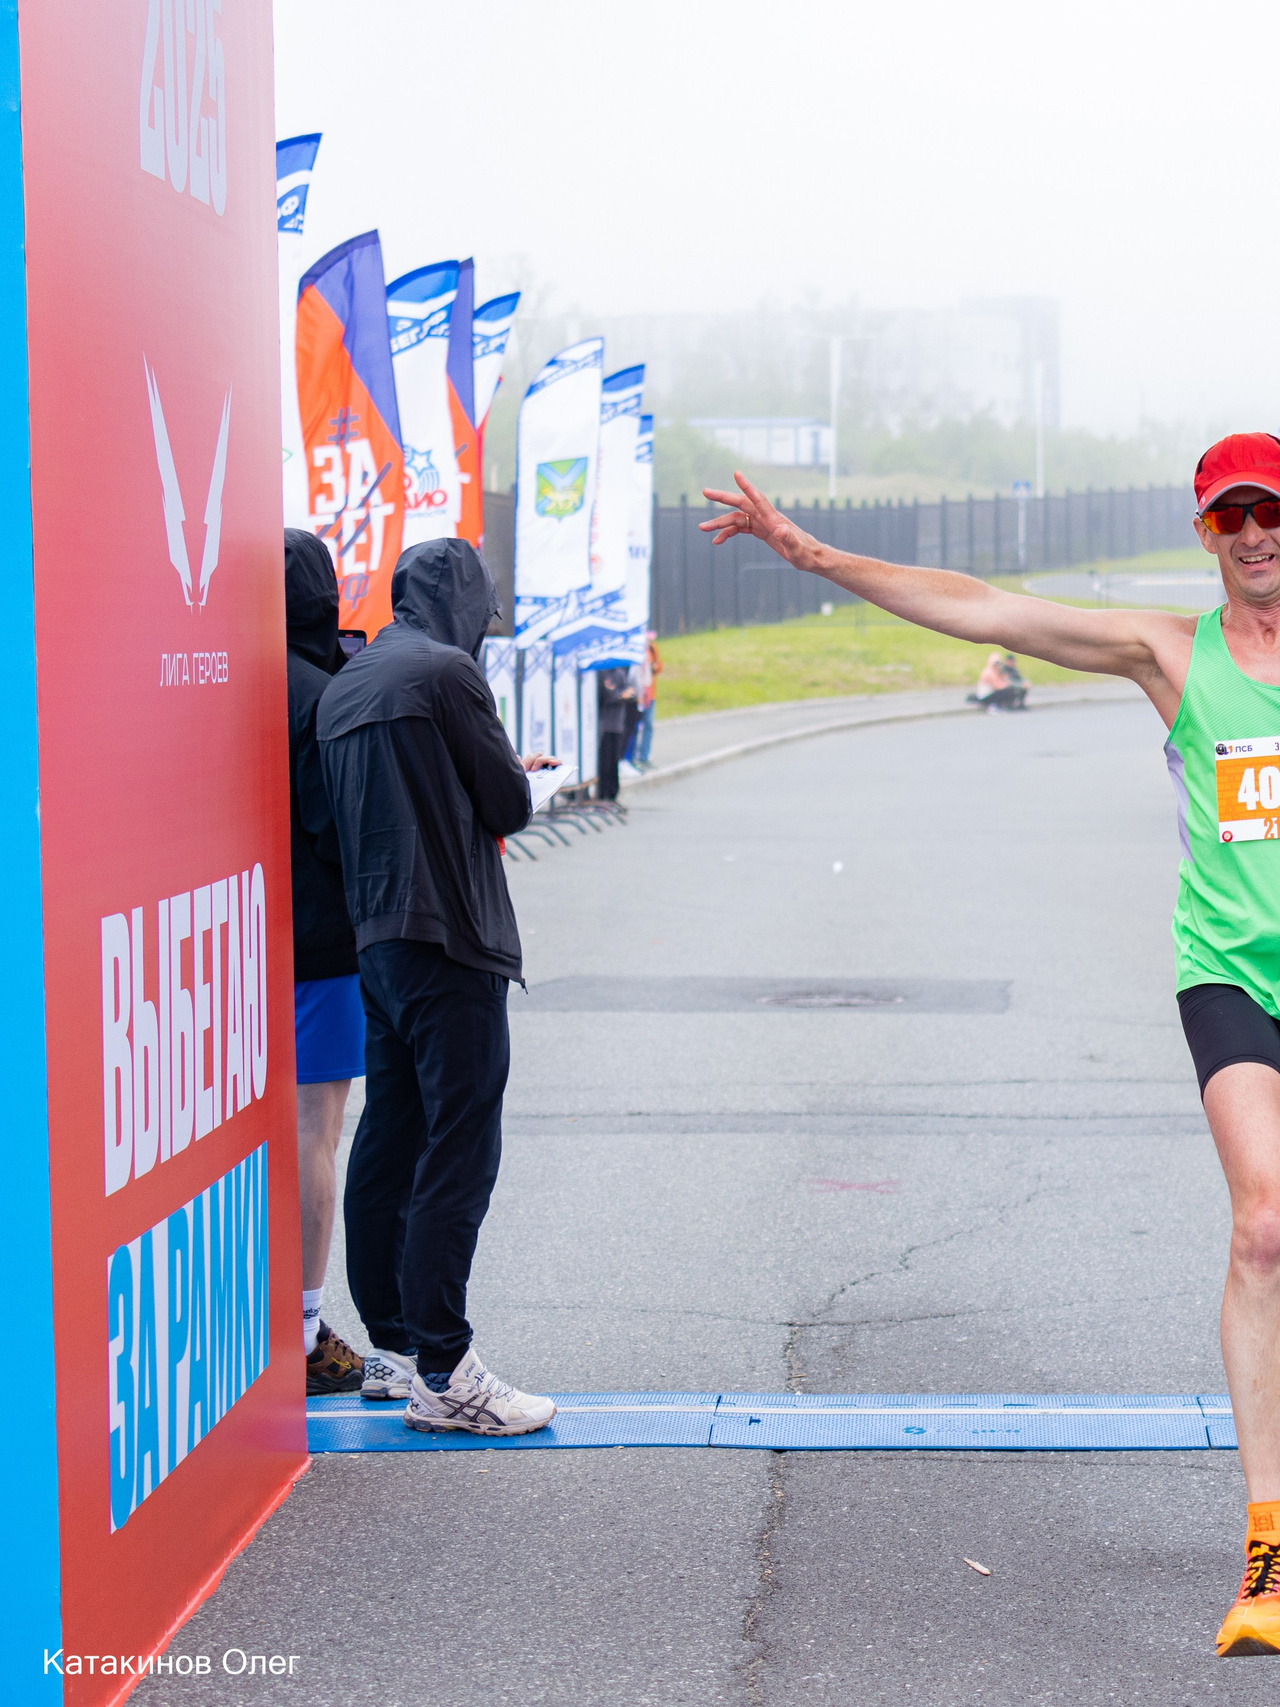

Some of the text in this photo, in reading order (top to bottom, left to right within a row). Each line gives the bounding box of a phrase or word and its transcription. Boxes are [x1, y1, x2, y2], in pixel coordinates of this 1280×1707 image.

[139, 0, 227, 217] 2025
[312, 438, 384, 514] ЗА
[160, 651, 229, 687] ЛИГА ГЕРОЕВ
[1235, 744, 1253, 753] ПСБ
[101, 862, 266, 1198] ВЫБЕГАЮ
[108, 1140, 269, 1531] ЗА РАМКИ
